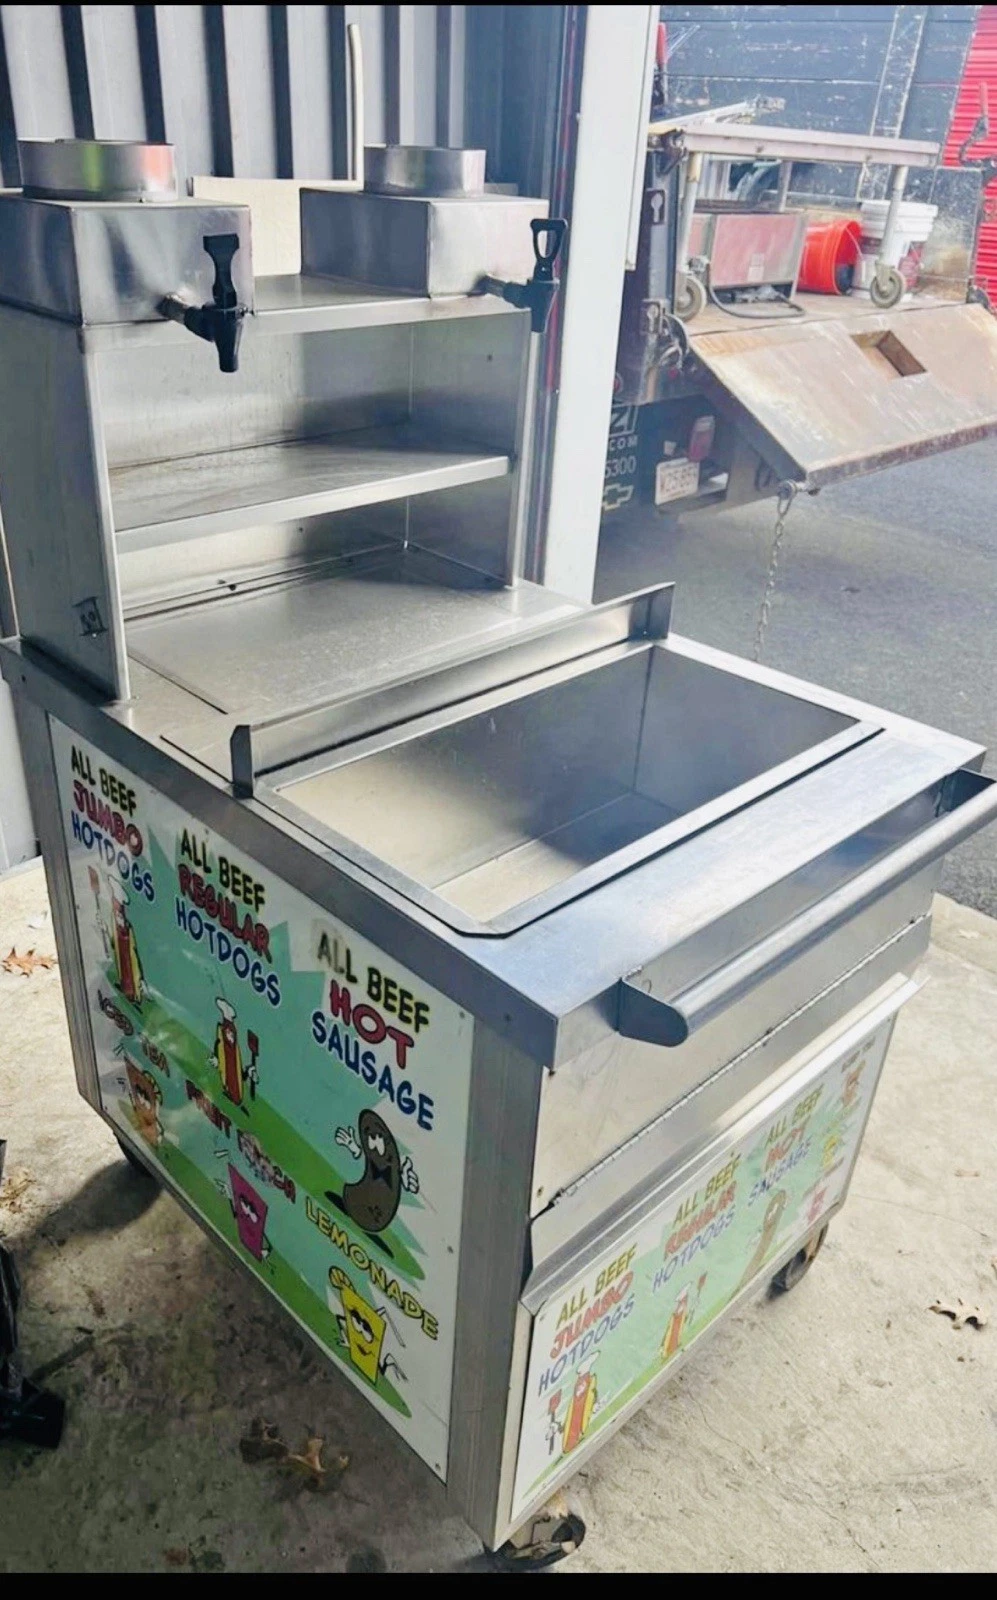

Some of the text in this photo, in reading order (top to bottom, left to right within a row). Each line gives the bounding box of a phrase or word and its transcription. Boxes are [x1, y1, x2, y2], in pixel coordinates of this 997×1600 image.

[71, 746, 137, 817] ALL BEEF
[73, 779, 144, 857] JUMBO
[71, 810, 155, 902] HOTDOGS
[181, 828, 266, 912] ALL BEEF
[176, 897, 281, 1006] HOTDOGS
[177, 864, 273, 964] REGULAR
[317, 932, 430, 1033] ALL BEEF
[329, 979, 415, 1070] HOT
[312, 1010, 434, 1131] SAUSAGE
[672, 1154, 741, 1229] ALL BEEF
[305, 1195, 439, 1340] LEMONADE
[556, 1243, 637, 1331] ALL BEEF
[652, 1204, 736, 1294] HOTDOGS
[538, 1292, 635, 1397] HOTDOGS
